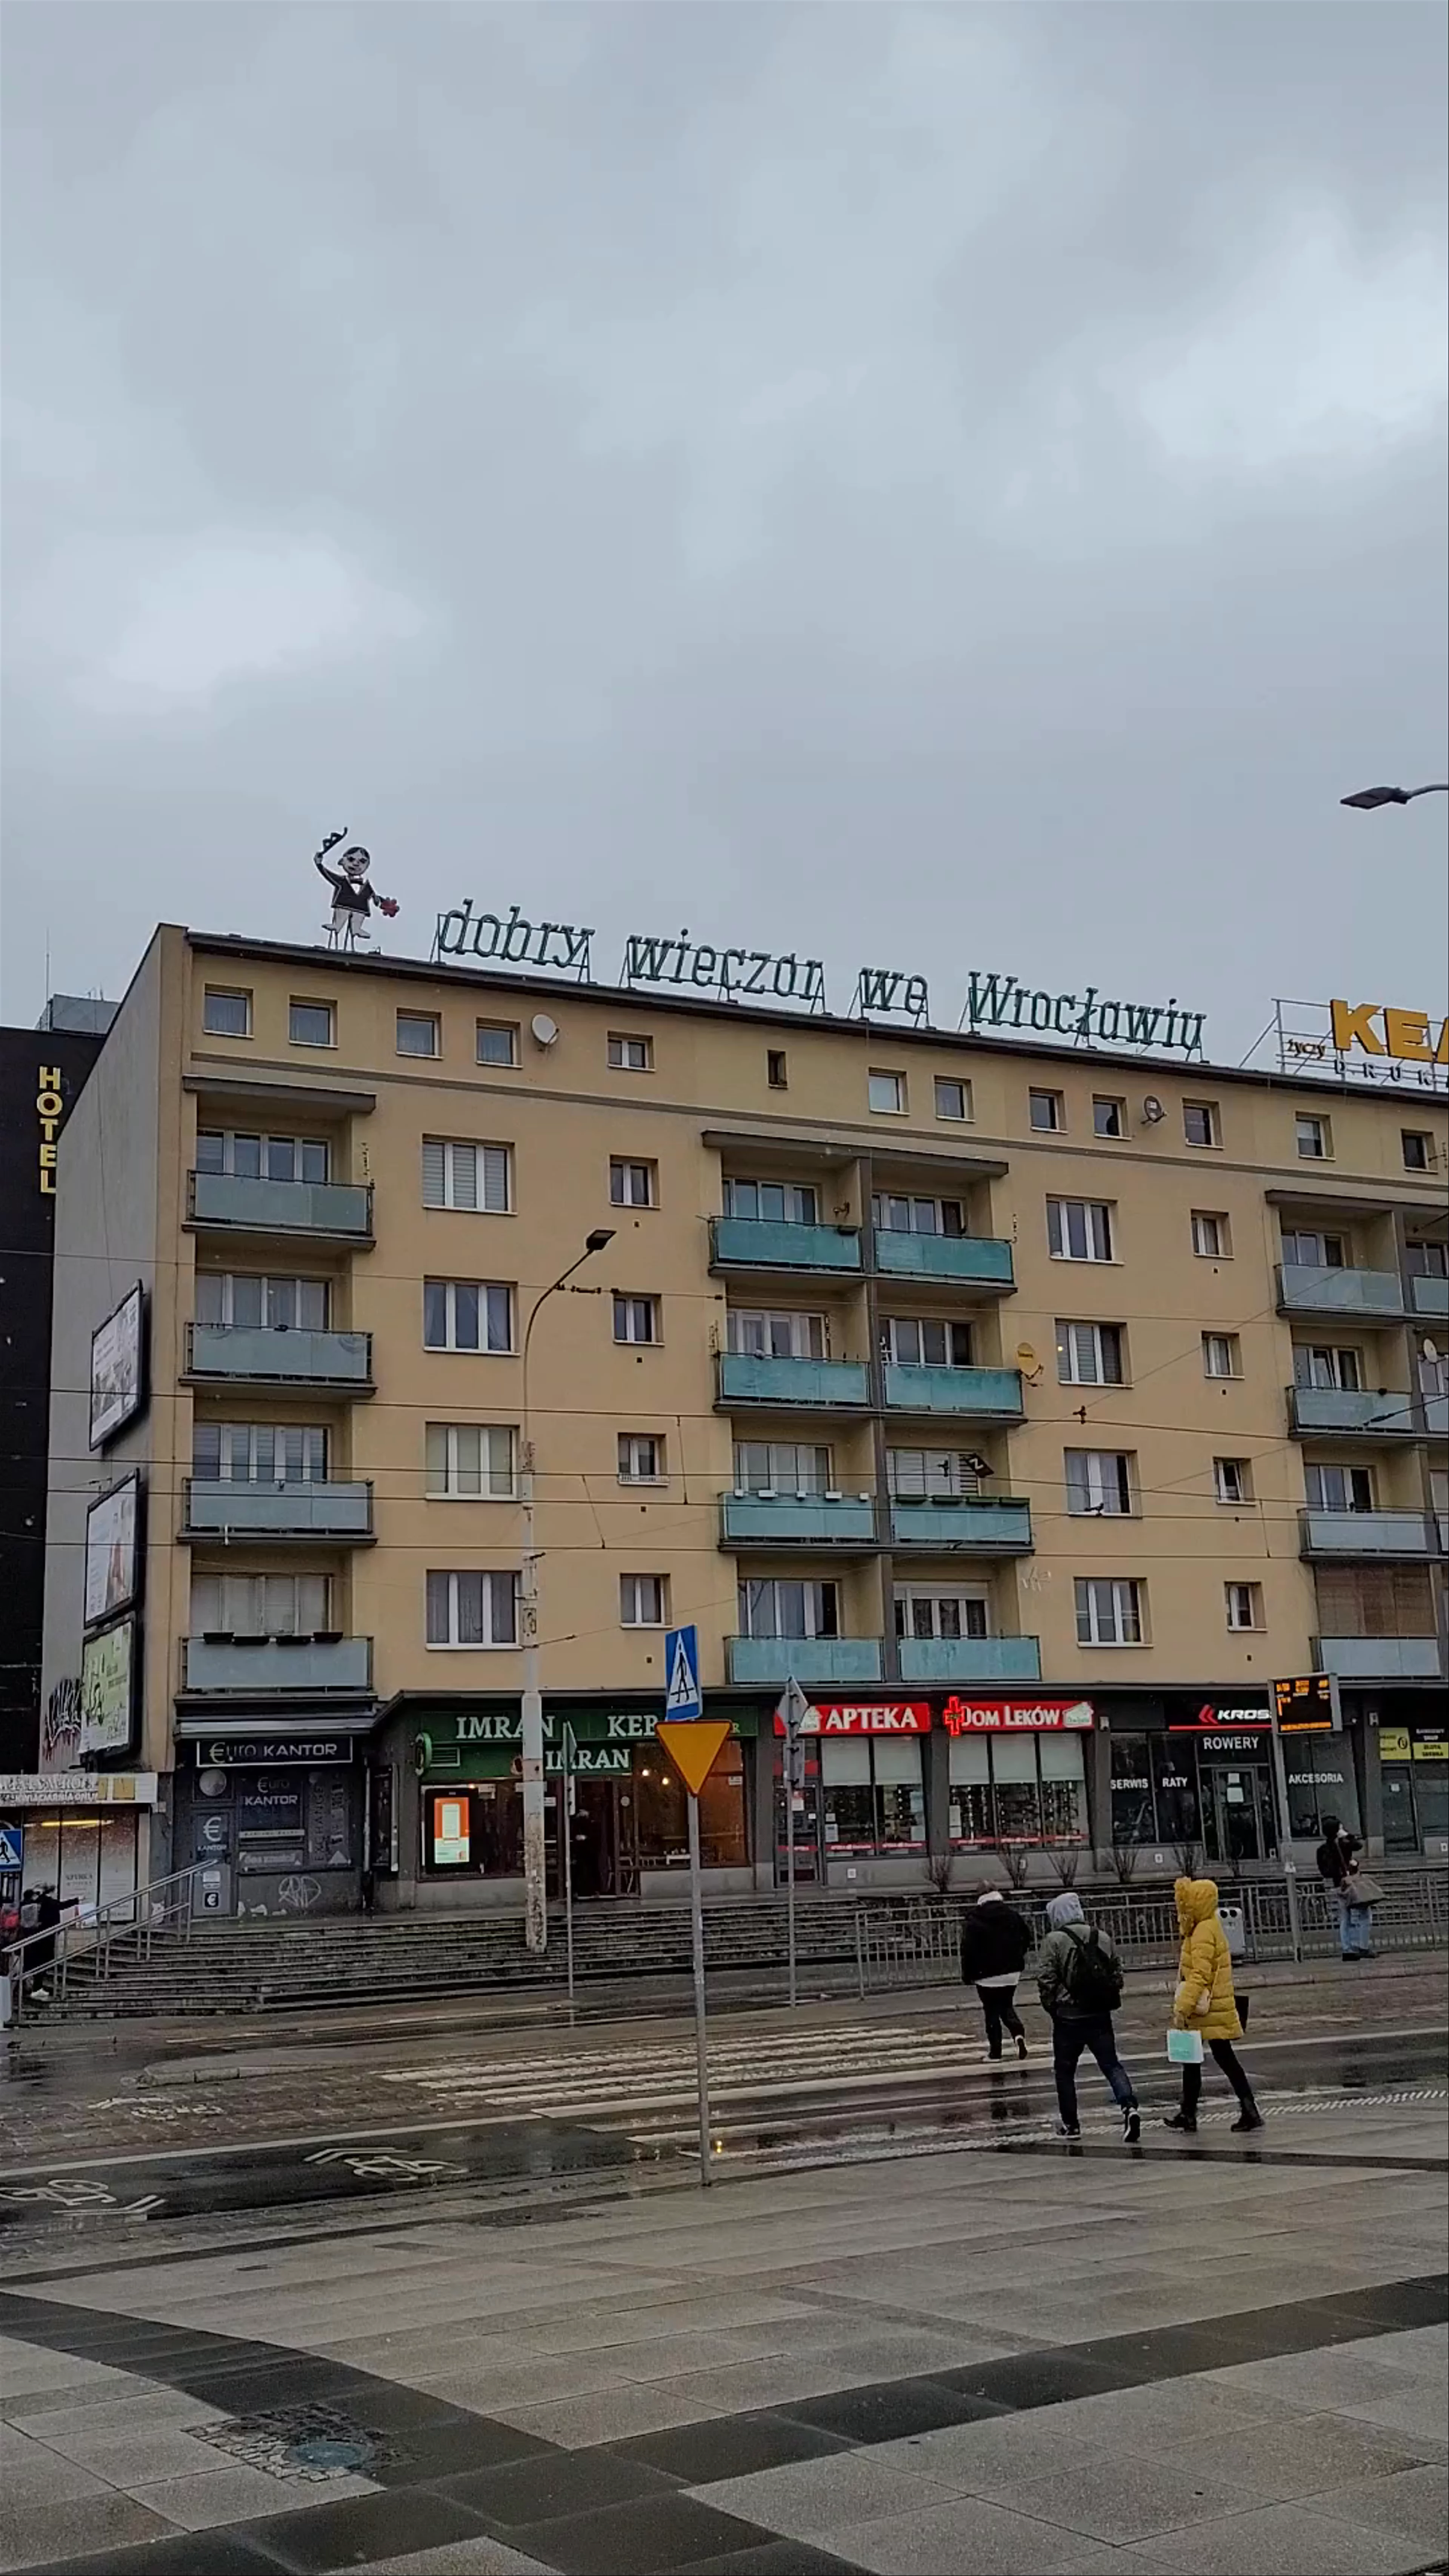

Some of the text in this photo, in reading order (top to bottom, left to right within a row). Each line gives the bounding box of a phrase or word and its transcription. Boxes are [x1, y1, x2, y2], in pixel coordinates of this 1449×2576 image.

[440, 898, 1207, 1050] dobry wieczór we Wrocławiu
[1330, 999, 1449, 1065] KE
[1334, 1059, 1449, 1087] DRUK
[37, 1066, 63, 1193] HOTEL
[826, 1707, 918, 1730] APTEKA
[1217, 1710, 1272, 1720] KROS
[1203, 1736, 1259, 1750] ROWERY
[264, 1744, 337, 1756] KANTOR
[1110, 1778, 1148, 1789] SERWIS
[1162, 1777, 1188, 1787] RATY
[1288, 1772, 1344, 1784] AKCESORIA
[245, 1795, 298, 1806] KANTOR
